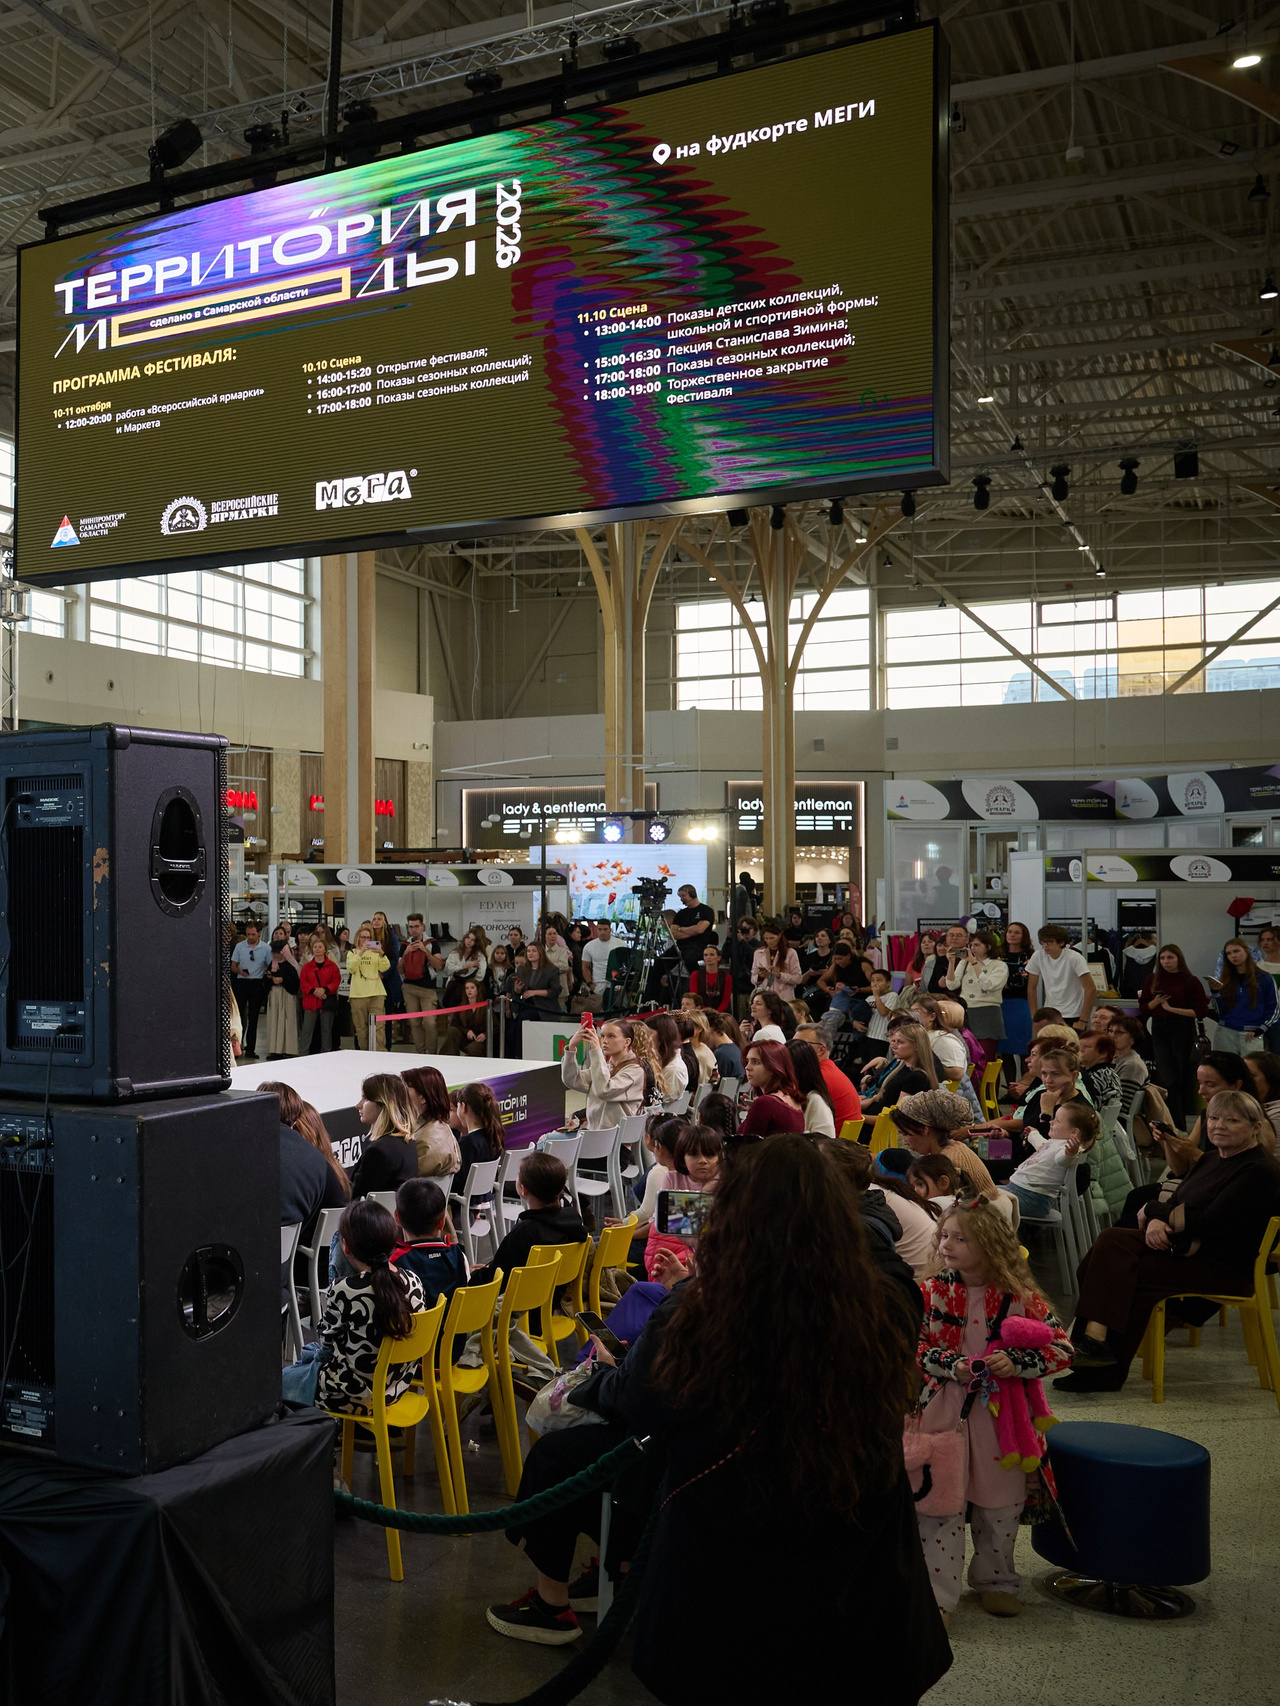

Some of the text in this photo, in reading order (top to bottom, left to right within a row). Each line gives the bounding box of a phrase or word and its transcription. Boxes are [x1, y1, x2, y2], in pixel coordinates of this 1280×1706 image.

[676, 99, 876, 159] на фудкорте МЕГИ
[495, 180, 522, 270] 2026
[149, 288, 309, 328] сделано в Самарской области
[577, 303, 648, 324] 11.10 Сцена
[594, 284, 844, 337] 13:00-14:00 Показы детских коллекций,
[667, 294, 879, 339] школьной и спортивной формы;
[594, 318, 849, 369] 15:00-16:30 Лекция Станислава Зимина;
[594, 334, 856, 385] 17:00-18:00 Показы сезонных коллекций;
[53, 347, 237, 394] ПРОГРАММА ФЕСТИВАЛЯ:
[302, 354, 361, 373] 10.10 Сцена
[316, 347, 488, 385] 14:00-15:20 Открытие фестиваля;
[316, 354, 532, 400] 16:00-17:00 Показы сезонных коллекций;
[594, 355, 829, 401] 18:00-19:00 Торжественное закрытие
[53, 400, 111, 419] 10-11 октября
[65, 387, 265, 430] 12:00-20:00 работа «Всероссийской ярмарки»
[316, 370, 529, 415] 17:00-18:00 Показы сезонных коллекций
[666, 386, 733, 405] Фестиваля
[115, 418, 160, 435] и Маркета
[210, 505, 279, 523] ЯРМАРКИ
[211, 493, 279, 513] ВСЕРОССИЙСКИЕ
[79, 519, 119, 532] САМАРСКОЙ
[79, 528, 109, 538] ОБЛАСТИ
[502, 801, 606, 817] lady & gentlema
[738, 798, 853, 813] lady entleman
